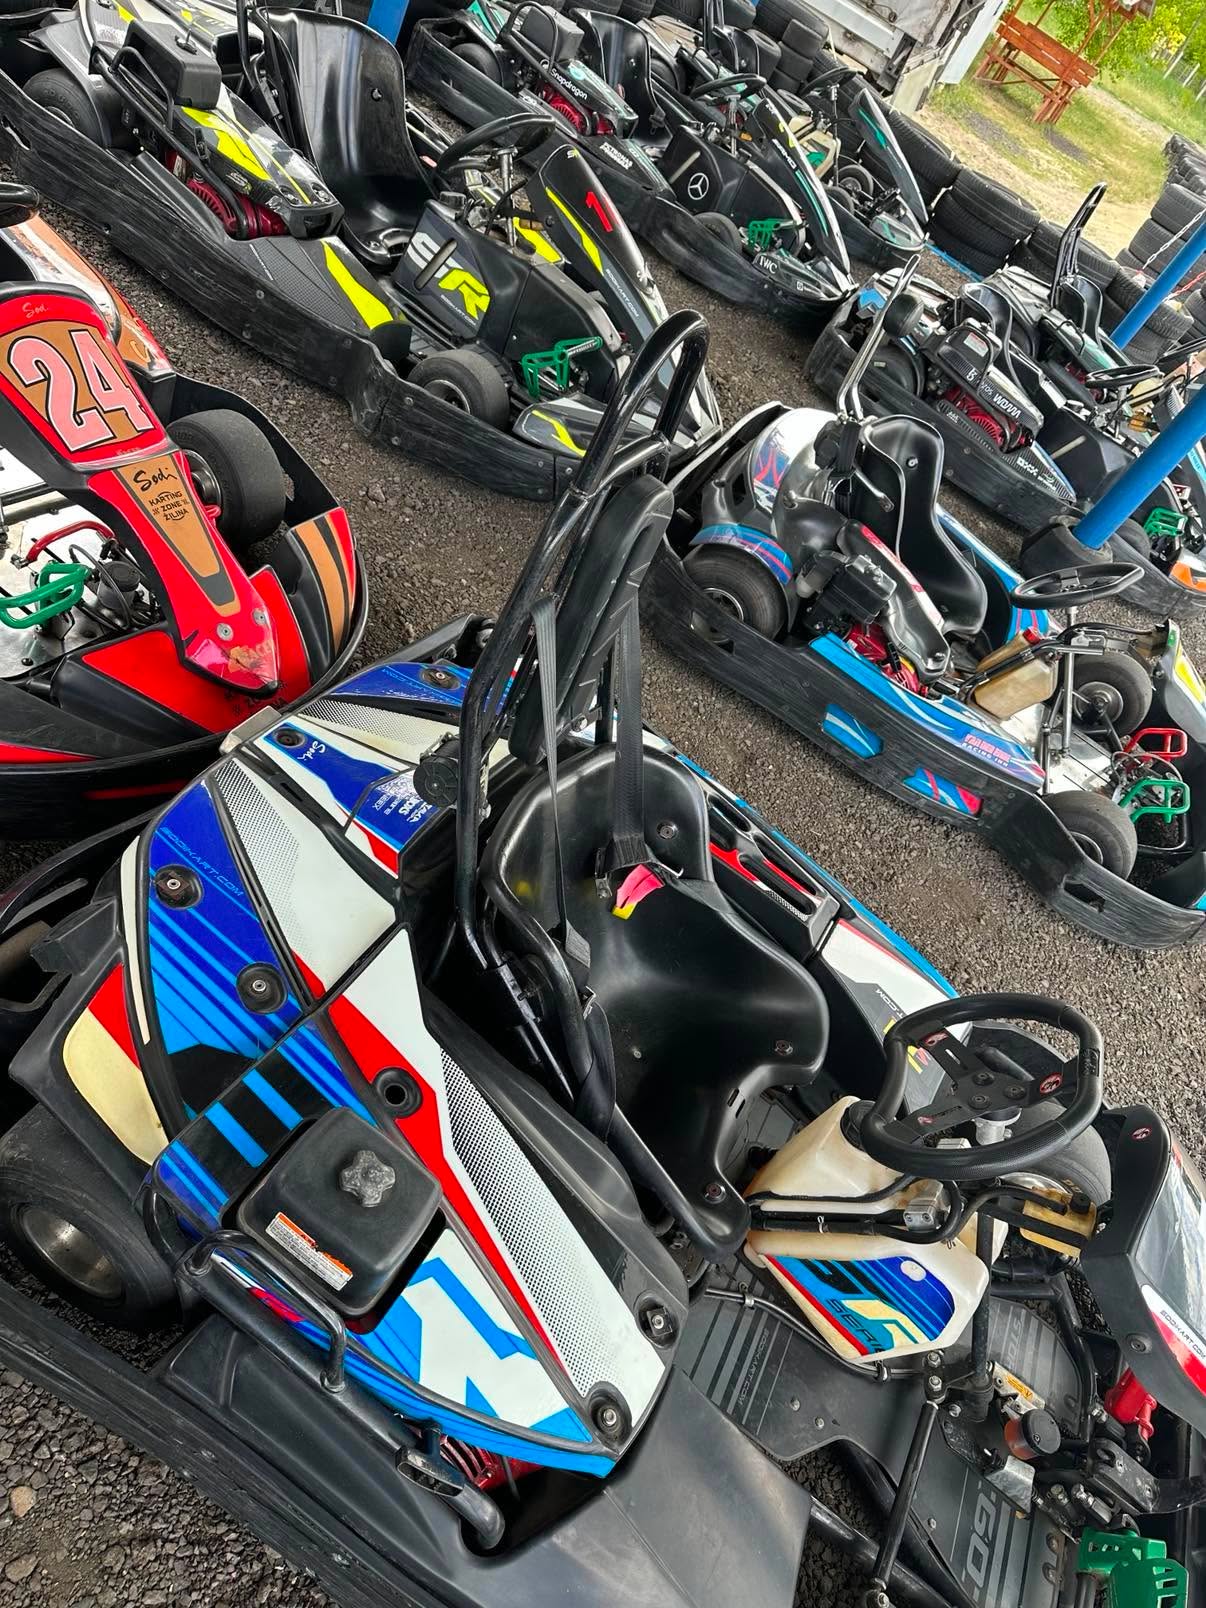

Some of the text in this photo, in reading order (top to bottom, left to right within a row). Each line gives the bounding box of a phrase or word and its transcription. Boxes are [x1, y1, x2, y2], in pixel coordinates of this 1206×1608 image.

[550, 68, 588, 100] Snapdragon
[760, 256, 778, 275] IWC
[8, 328, 156, 453] 24
[133, 467, 178, 492] Sodi
[148, 490, 183, 506] KARTING
[160, 500, 182, 512] ZONE
[163, 508, 190, 521] ŽILINA
[159, 827, 244, 897] SODIKART.COM
[966, 1492, 997, 1589] GO
